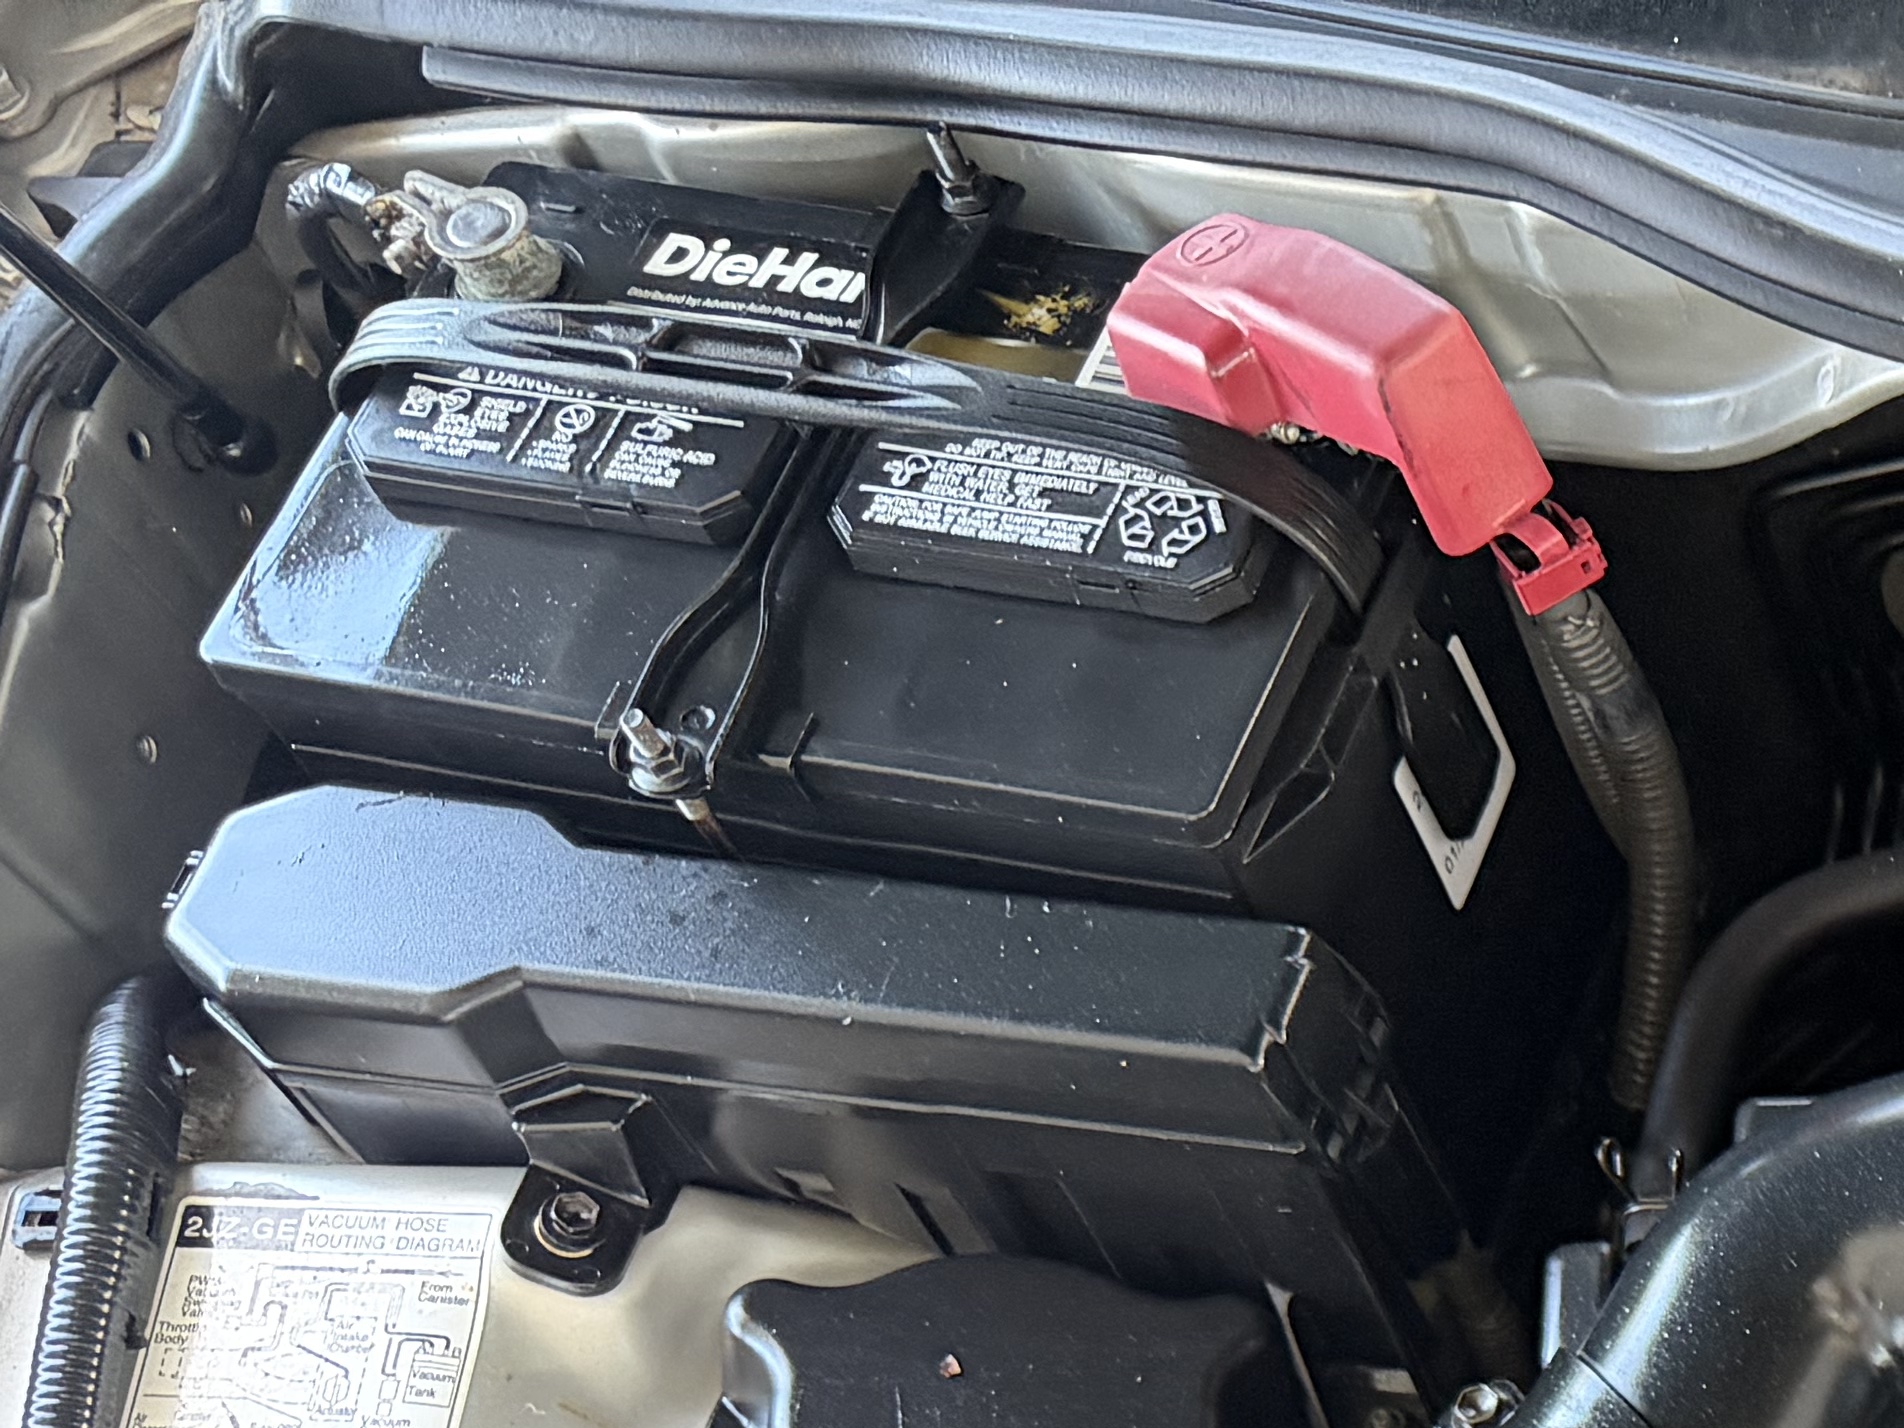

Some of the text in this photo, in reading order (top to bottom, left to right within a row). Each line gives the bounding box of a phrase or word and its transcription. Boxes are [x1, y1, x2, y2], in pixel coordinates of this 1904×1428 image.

[643, 232, 866, 303] DieHar
[933, 459, 973, 476] FLUSH
[976, 464, 1012, 480] EYES
[928, 472, 962, 487] WITH
[922, 481, 1053, 511] MEDICAL HELP FAST
[183, 1215, 298, 1242] 2JZ-GE
[308, 1214, 449, 1232] VACUUM HOSE
[301, 1232, 386, 1249] ROUTING
[422, 1281, 453, 1292] From
[412, 1369, 455, 1383] Vacuum
[407, 1385, 437, 1398] Tank
